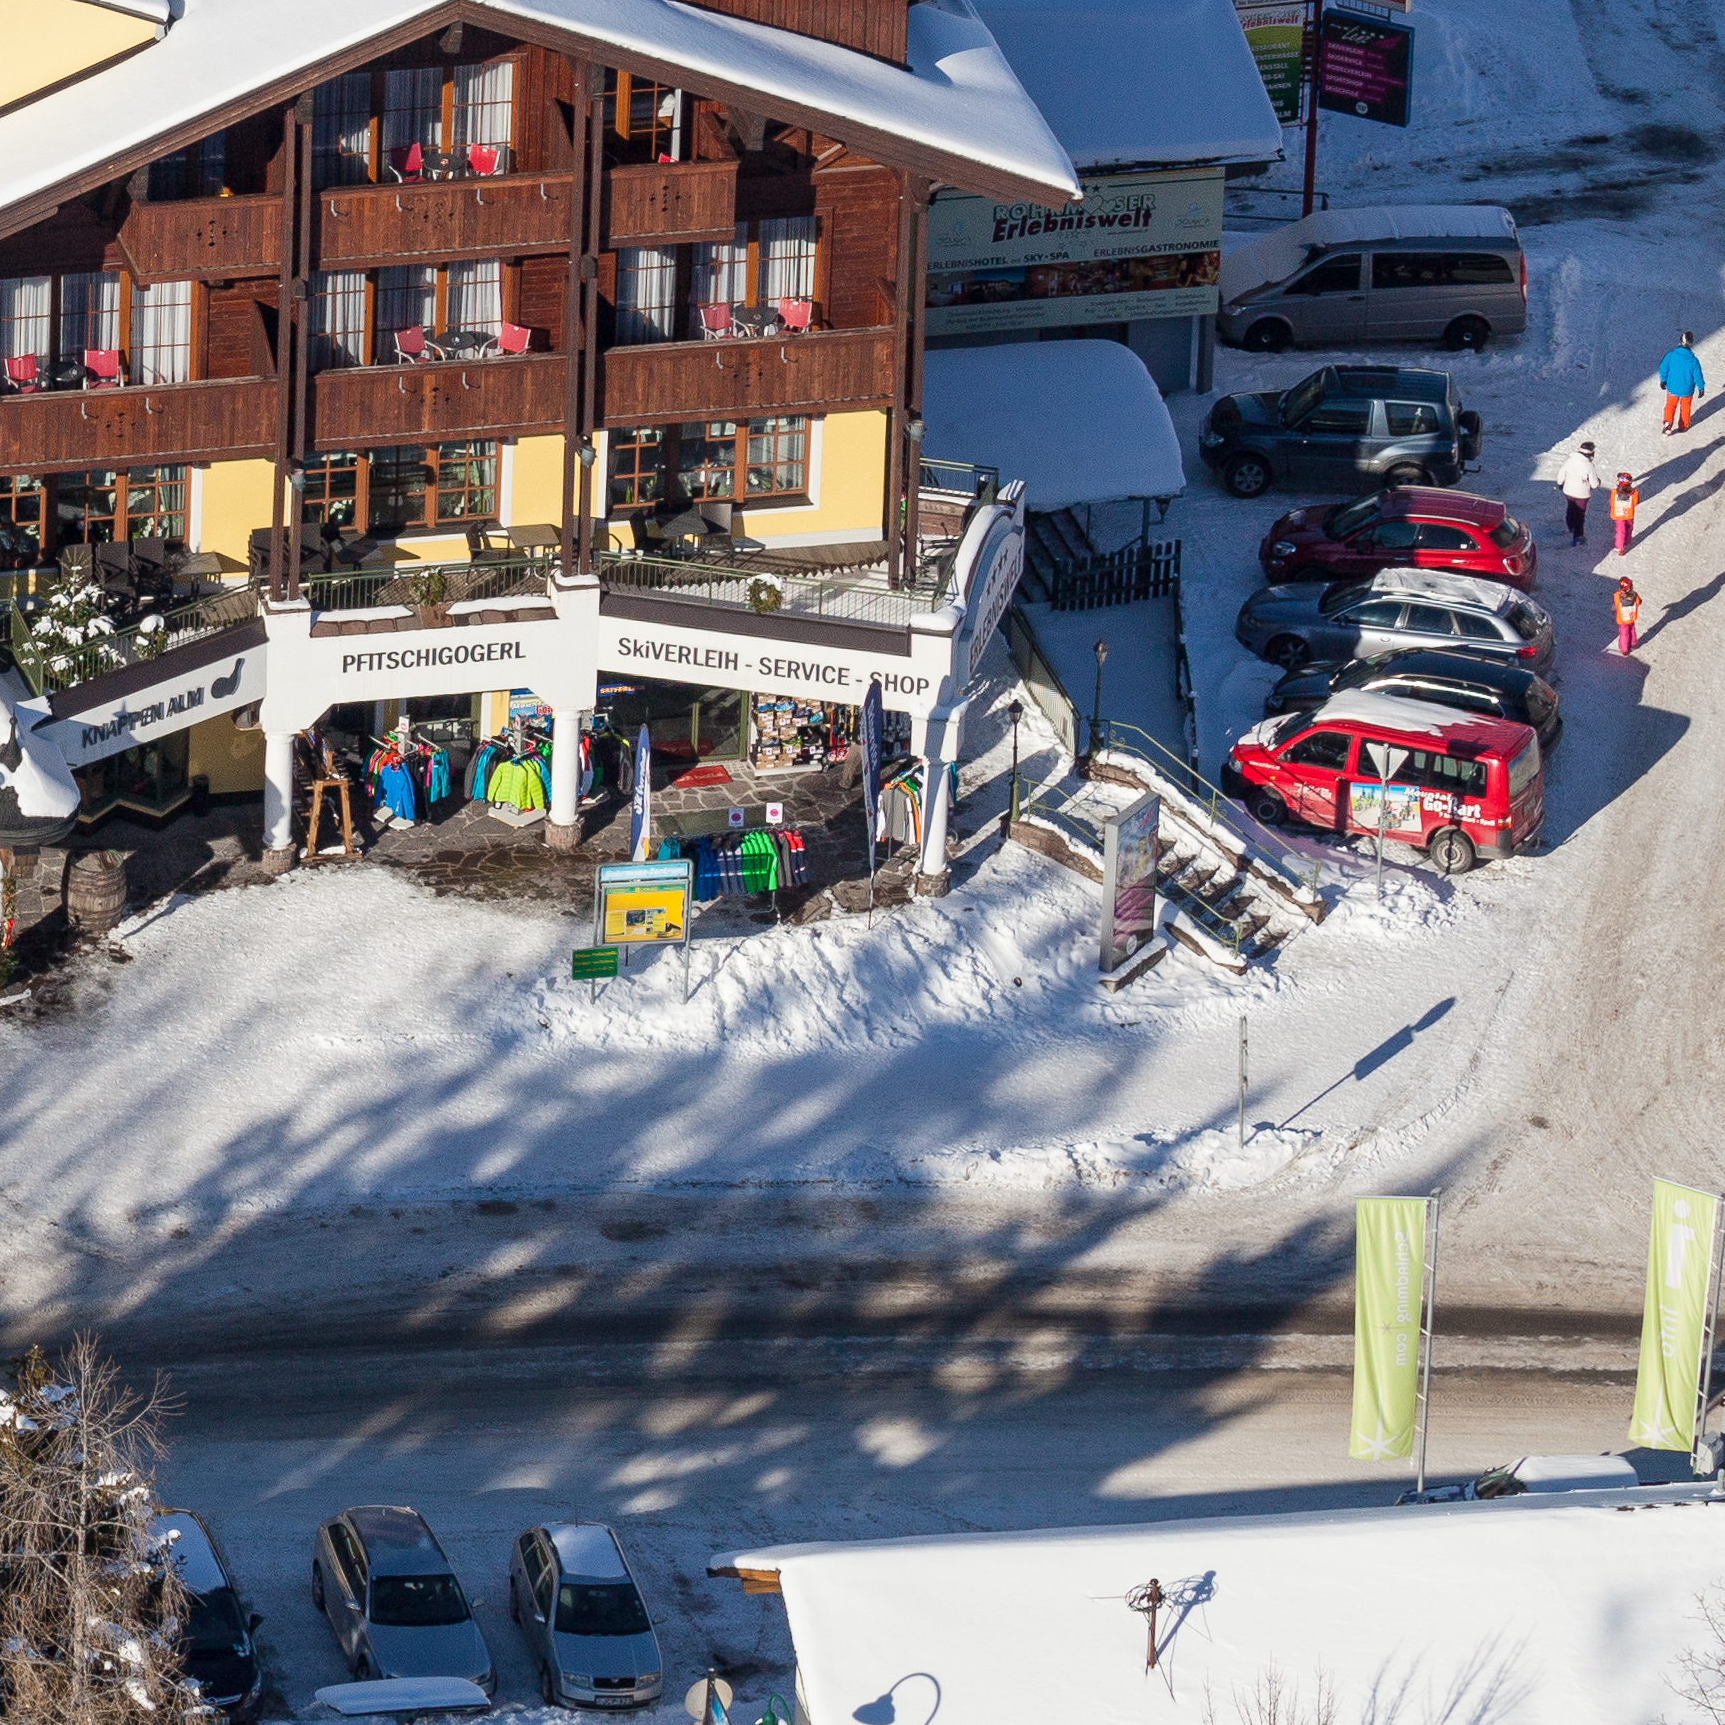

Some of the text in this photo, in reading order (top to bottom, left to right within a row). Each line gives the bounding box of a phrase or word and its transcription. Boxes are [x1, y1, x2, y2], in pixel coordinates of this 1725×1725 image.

[992, 206, 1152, 243] Erlebniswelt
[927, 256, 1008, 270] ERLEBNISHOTEL
[1093, 239, 1220, 257] ERLEBNISGASTRONOMIE
[342, 641, 526, 674] PFITSCHIGOGERL
[617, 636, 739, 671] SkiVERLEIH
[758, 656, 850, 686] SERVICE
[869, 671, 930, 696] SHOP
[81, 687, 205, 749] KNAPPEN ALM
